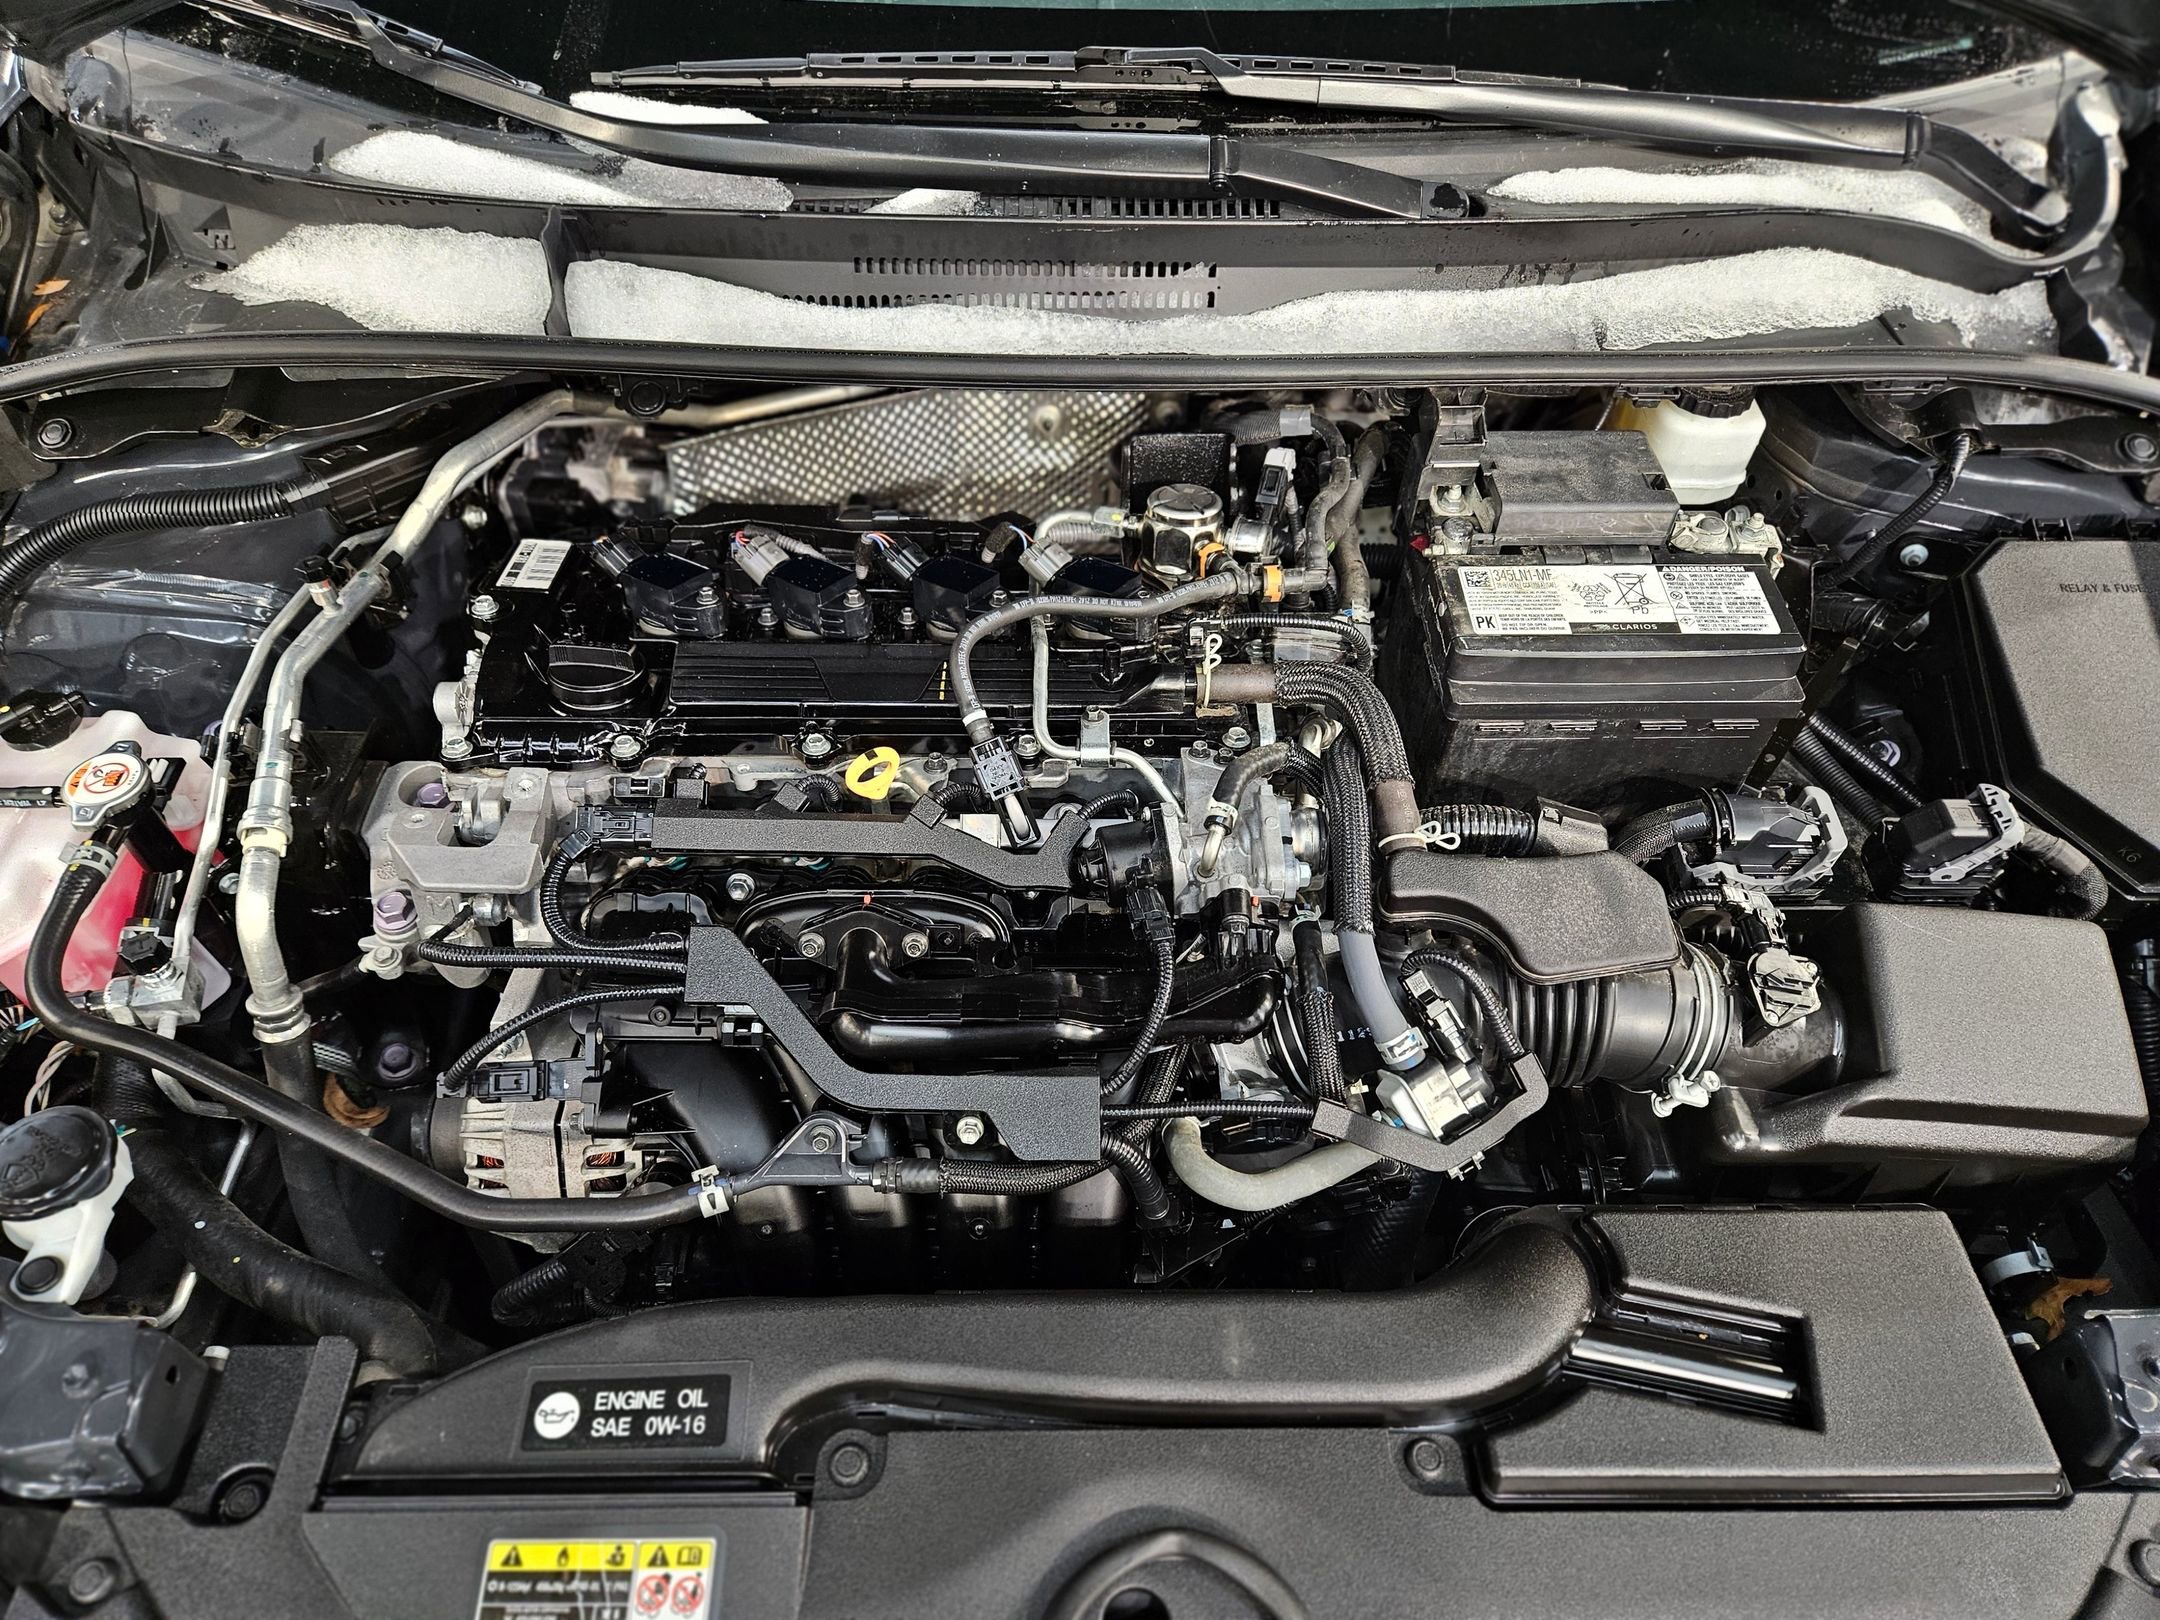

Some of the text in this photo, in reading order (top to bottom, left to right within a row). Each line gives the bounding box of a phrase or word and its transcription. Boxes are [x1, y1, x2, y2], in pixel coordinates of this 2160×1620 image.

[2060, 584, 2097, 593] RELAY
[2102, 584, 2111, 593] &
[1632, 606, 1649, 614] Pb
[1476, 616, 1496, 629] PK
[594, 1388, 709, 1411] ENGINE OIL
[590, 1415, 706, 1437] SAE 0W-16
